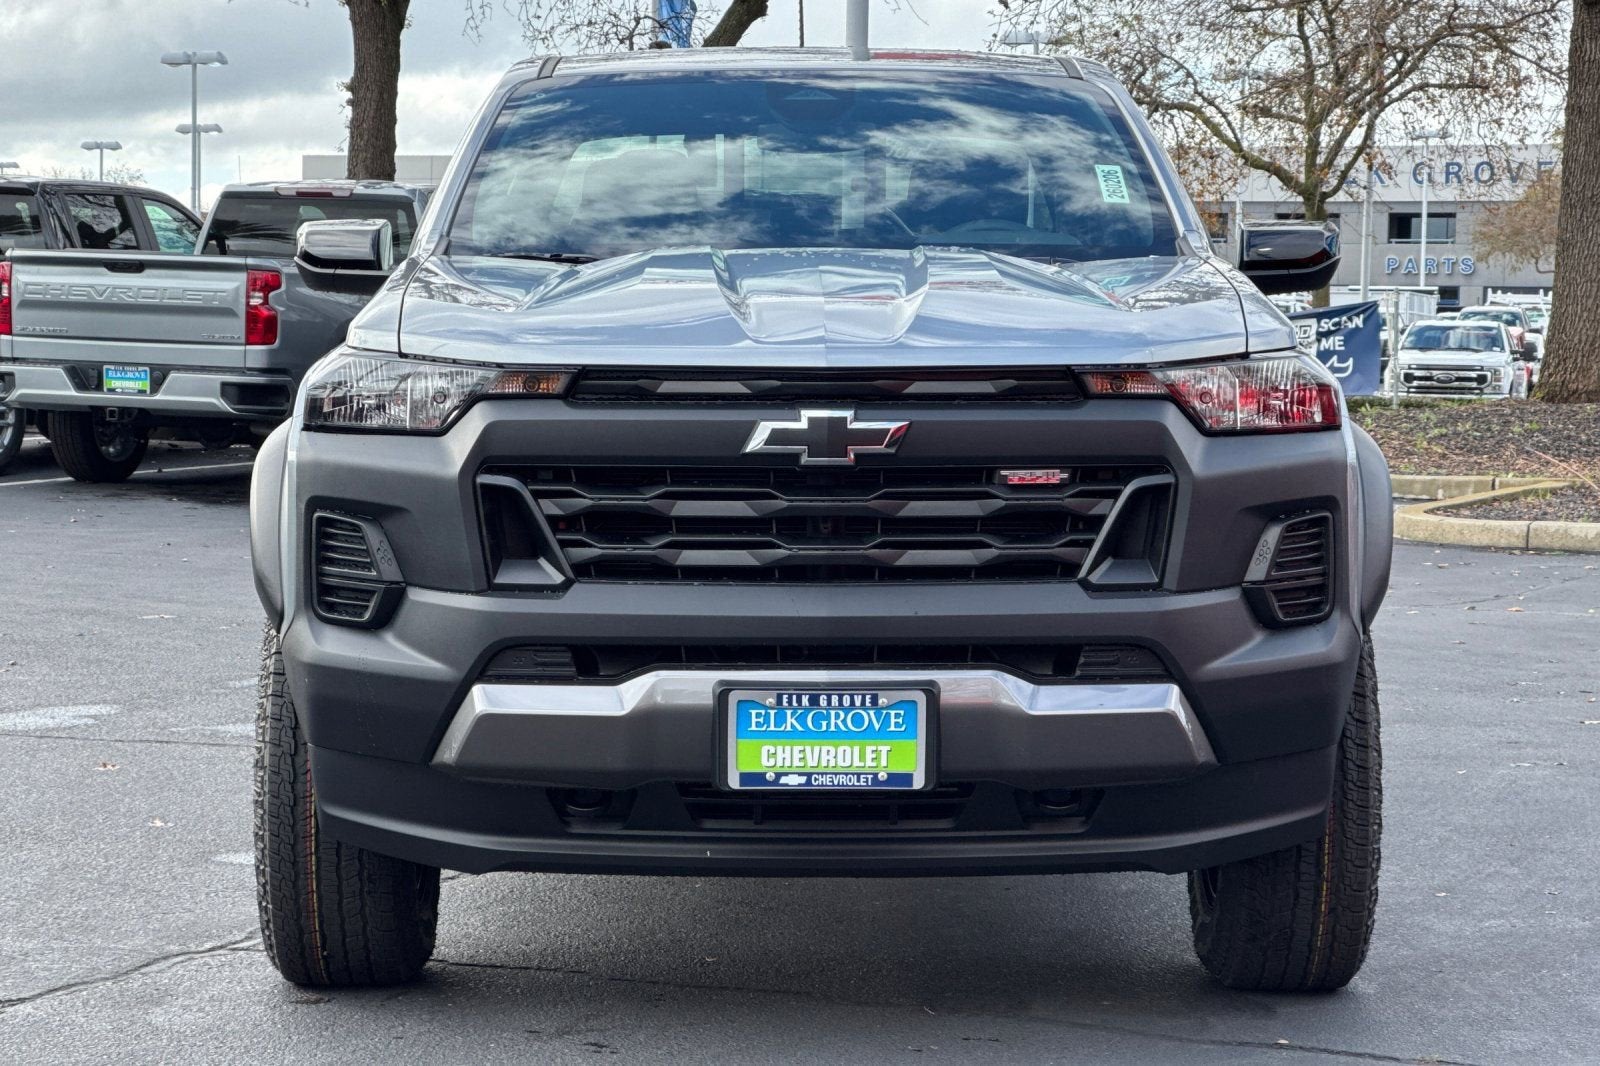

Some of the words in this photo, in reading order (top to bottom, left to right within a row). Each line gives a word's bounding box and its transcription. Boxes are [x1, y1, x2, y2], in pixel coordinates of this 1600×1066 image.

[1101, 169, 1126, 199] 260206
[1385, 256, 1475, 274] PARTS
[23, 282, 229, 304] CHEVROLET
[1318, 314, 1364, 332] SCAN
[1320, 336, 1345, 351] ME
[782, 694, 810, 707] ELK
[819, 694, 872, 707] GROVE
[748, 709, 806, 731] ELK
[807, 709, 907, 732] GROVE
[761, 745, 891, 768] CHEVROLET
[811, 774, 873, 786] CHEVROLET
